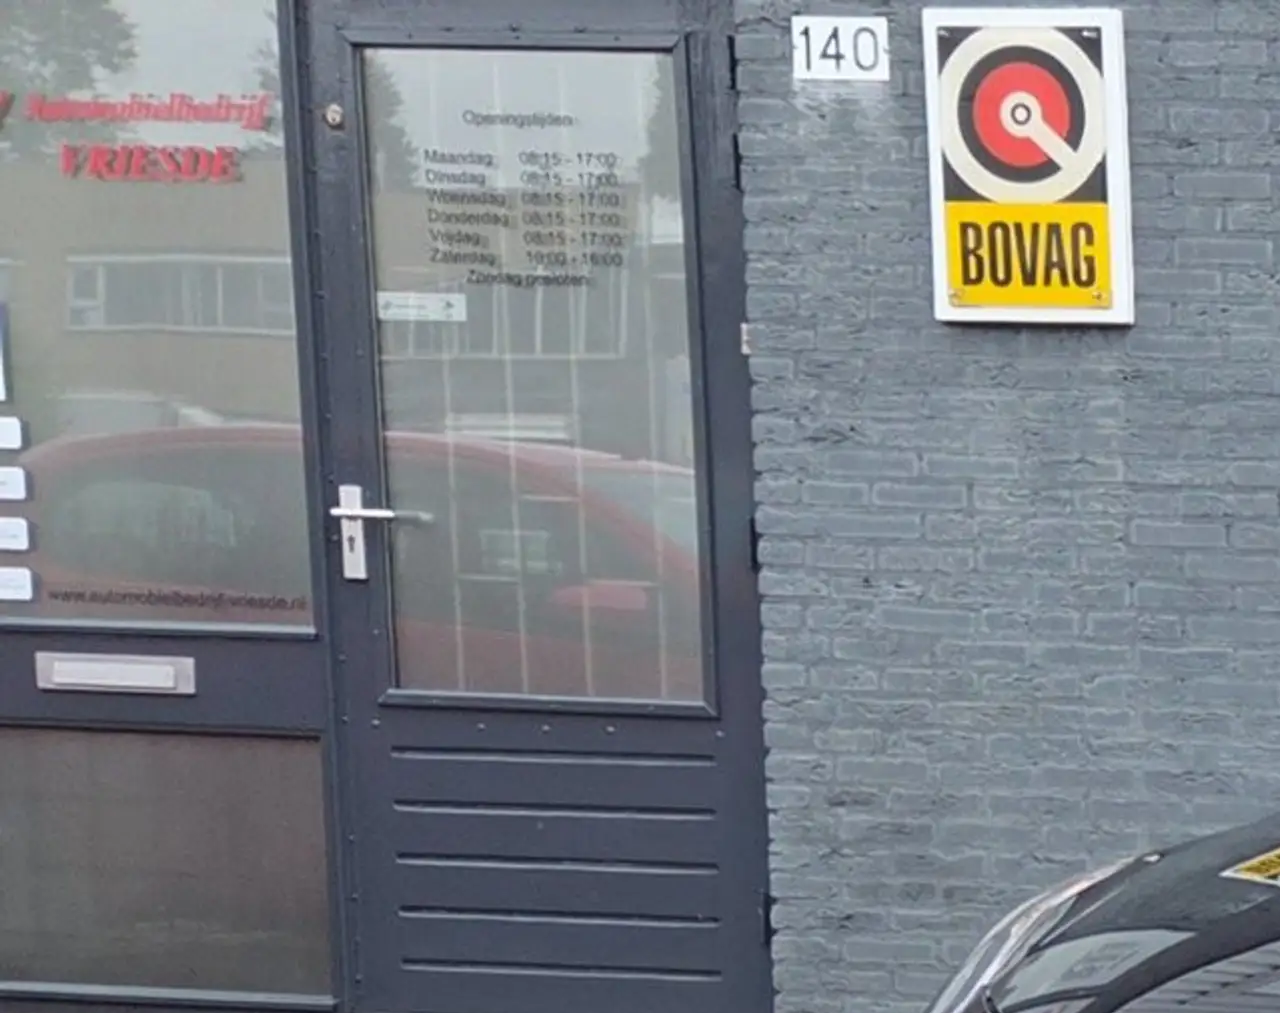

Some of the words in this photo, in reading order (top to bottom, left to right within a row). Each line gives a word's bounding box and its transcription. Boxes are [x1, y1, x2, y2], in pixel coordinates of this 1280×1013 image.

[799, 26, 880, 72] 140
[60, 141, 240, 181] VRIESDE
[959, 221, 1097, 288] BOVAG
